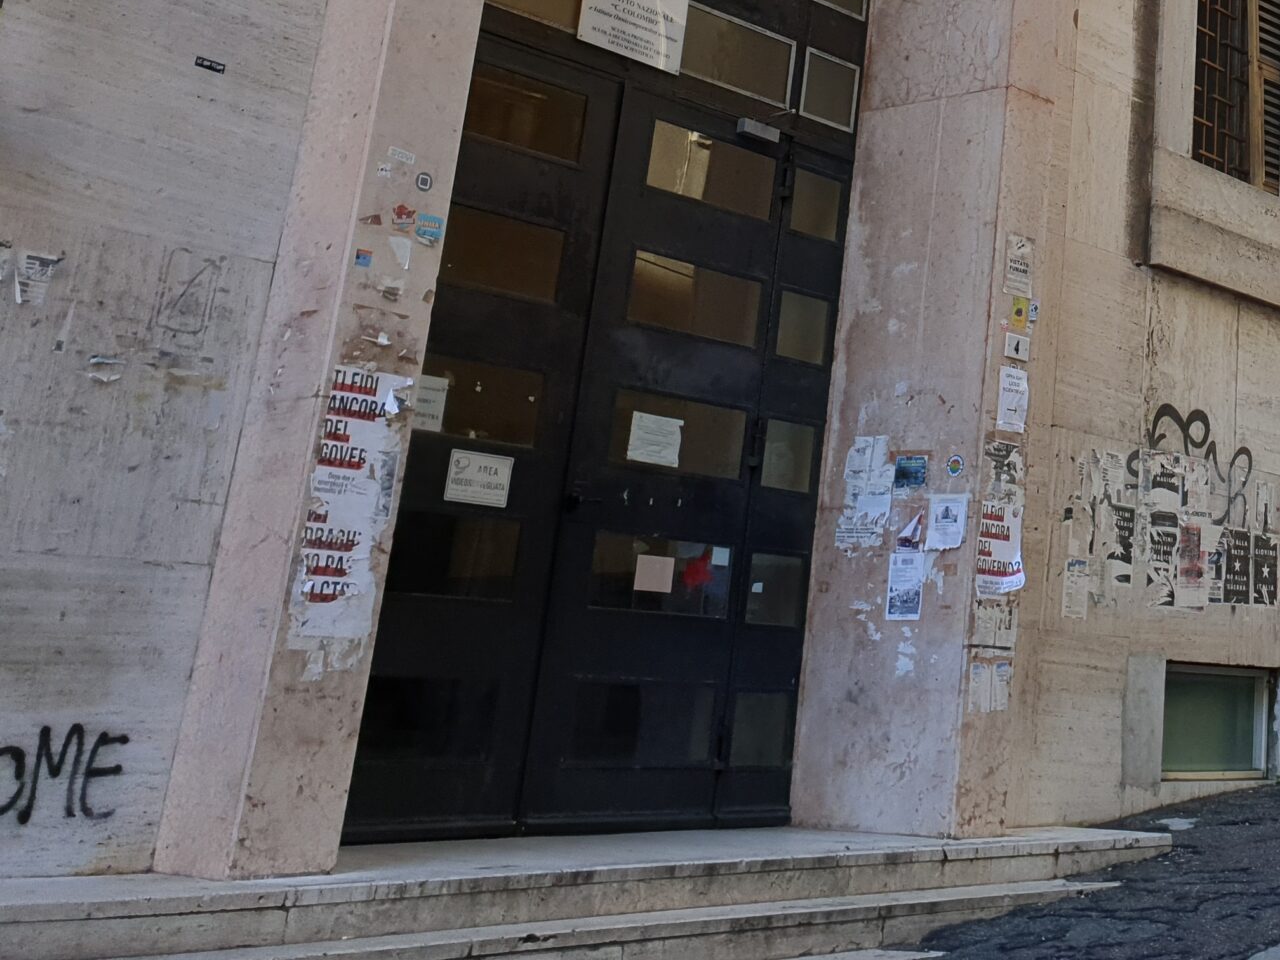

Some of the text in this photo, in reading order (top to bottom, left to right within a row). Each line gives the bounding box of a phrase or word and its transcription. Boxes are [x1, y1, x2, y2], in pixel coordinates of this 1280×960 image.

[1014, 340, 1020, 355] 4
[348, 372, 380, 397] FIDI
[327, 394, 387, 421] ANCORA
[477, 465, 499, 477] AREA
[303, 526, 362, 552] DRAGH
